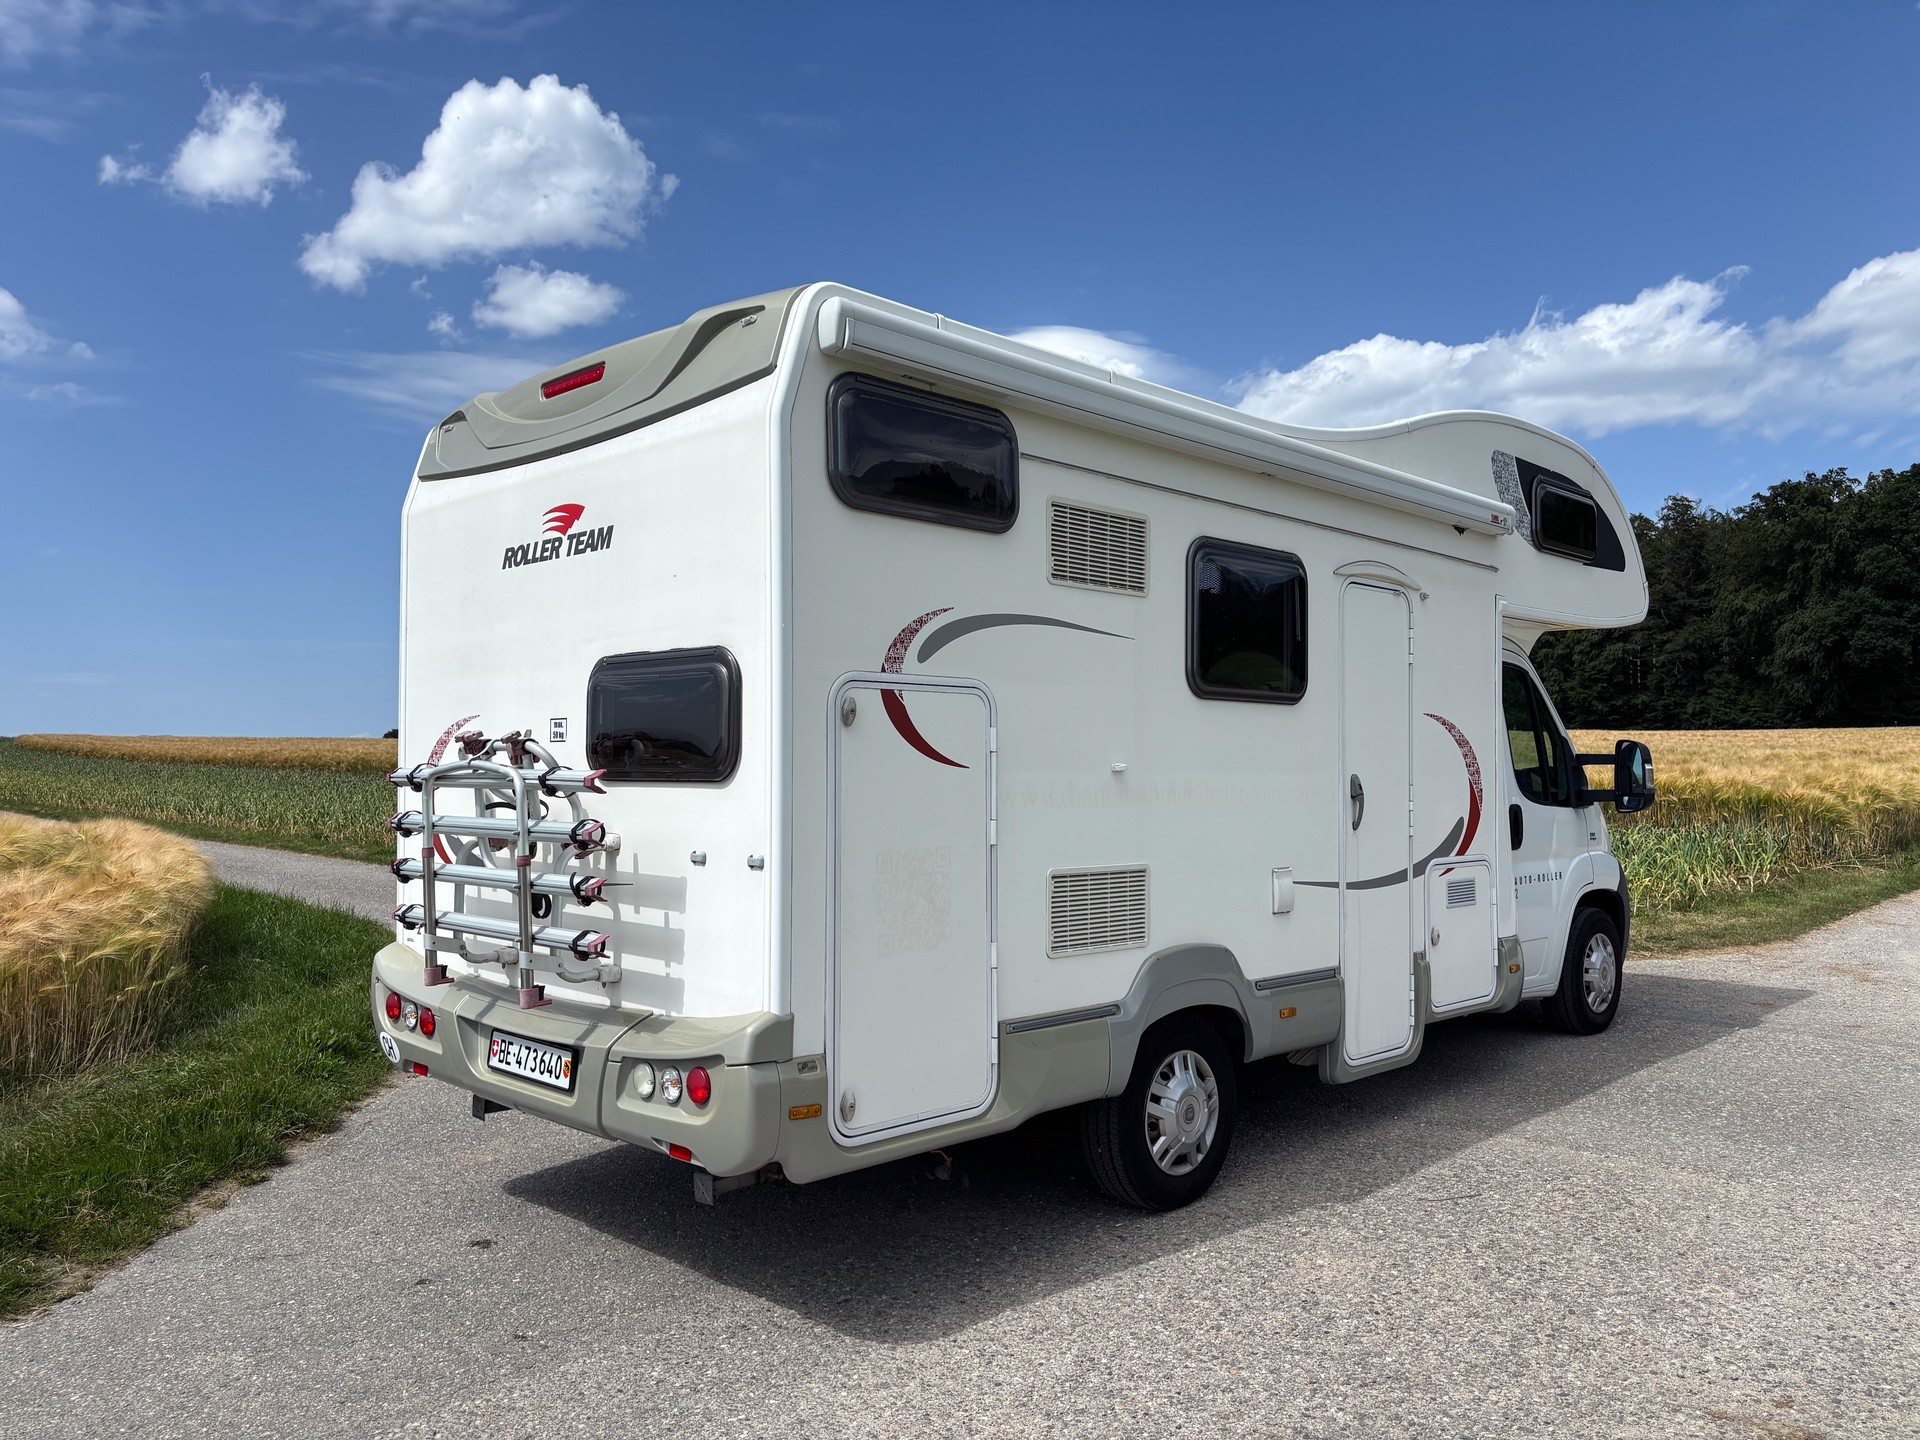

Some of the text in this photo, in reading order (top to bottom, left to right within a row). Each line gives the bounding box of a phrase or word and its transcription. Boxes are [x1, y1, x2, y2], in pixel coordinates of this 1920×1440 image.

[502, 525, 614, 570] ROLLER TEAM
[553, 721, 564, 729] max.
[553, 730, 564, 740] 50 kg
[382, 1036, 397, 1060] CH
